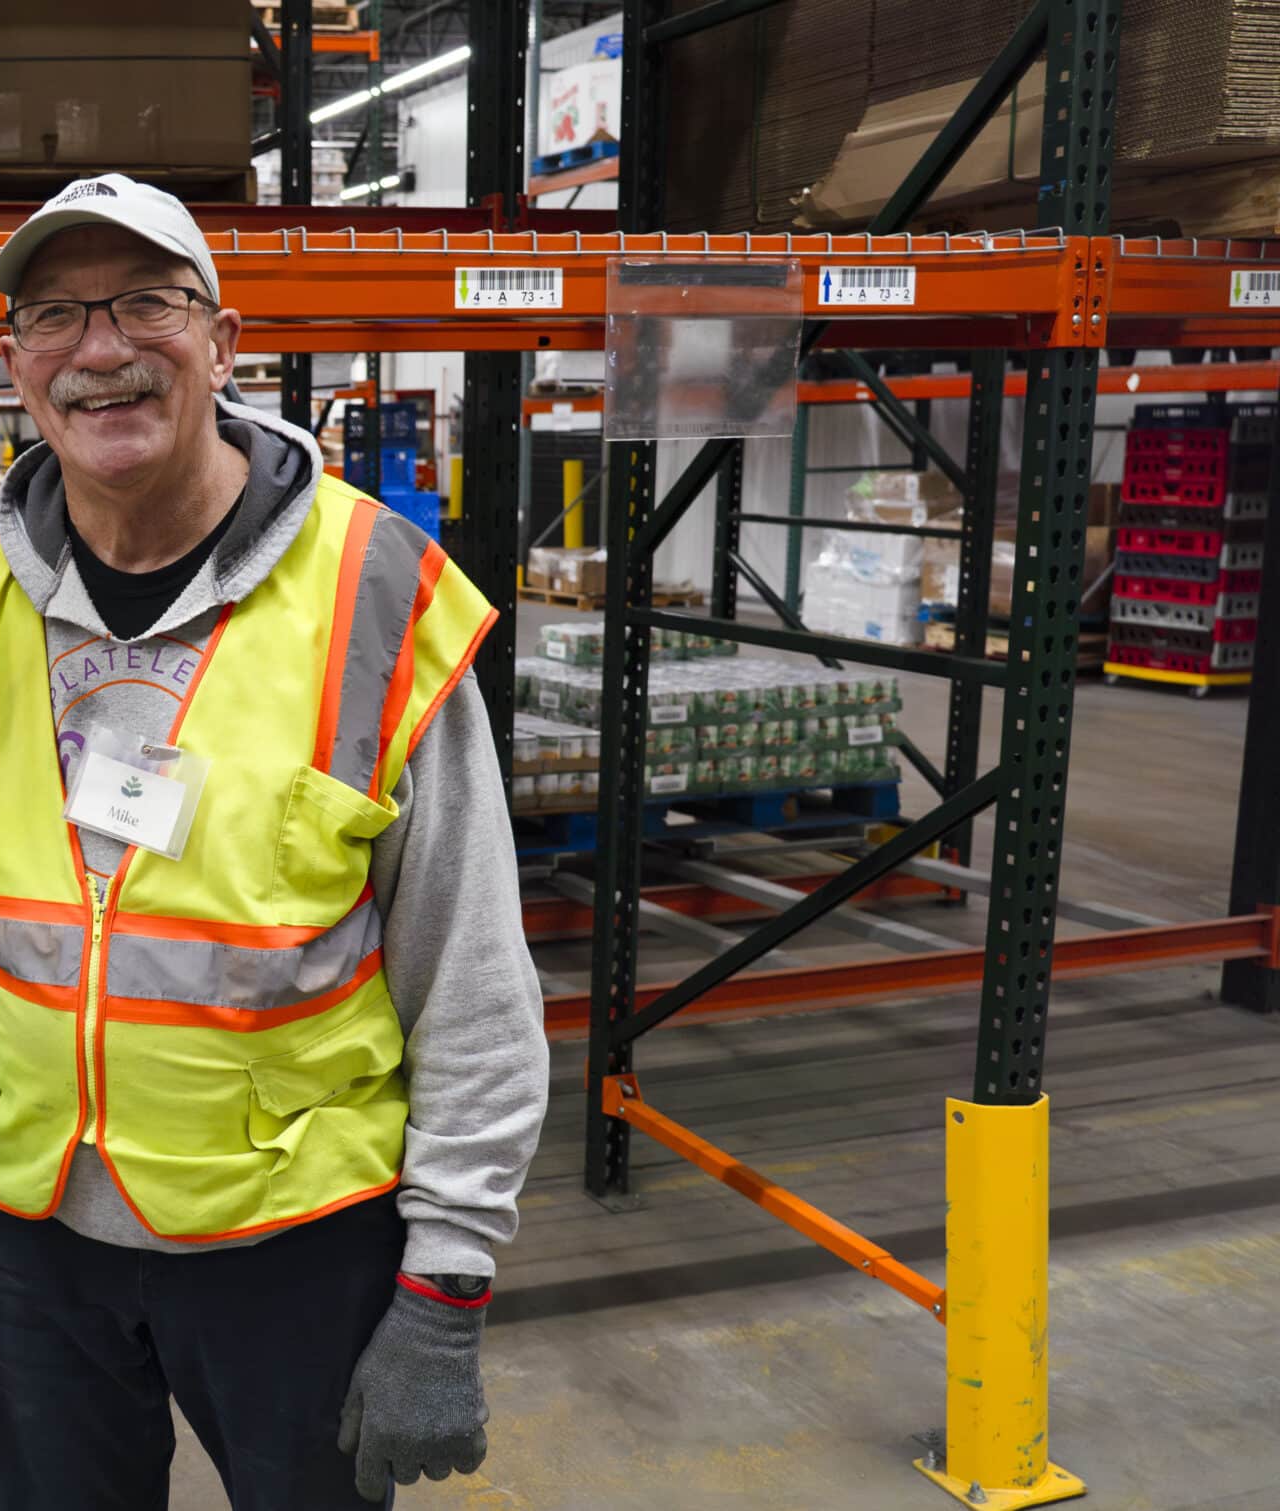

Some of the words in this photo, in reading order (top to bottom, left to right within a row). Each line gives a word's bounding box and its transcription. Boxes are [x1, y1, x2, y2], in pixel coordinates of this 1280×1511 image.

[473, 292, 480, 301] 4
[498, 292, 507, 302] A
[521, 292, 534, 302] 73
[549, 292, 555, 301] 1
[836, 289, 842, 298] 4
[859, 289, 866, 298] A
[880, 289, 890, 298] 73
[903, 289, 910, 298] 2
[107, 805, 140, 827] Mike
